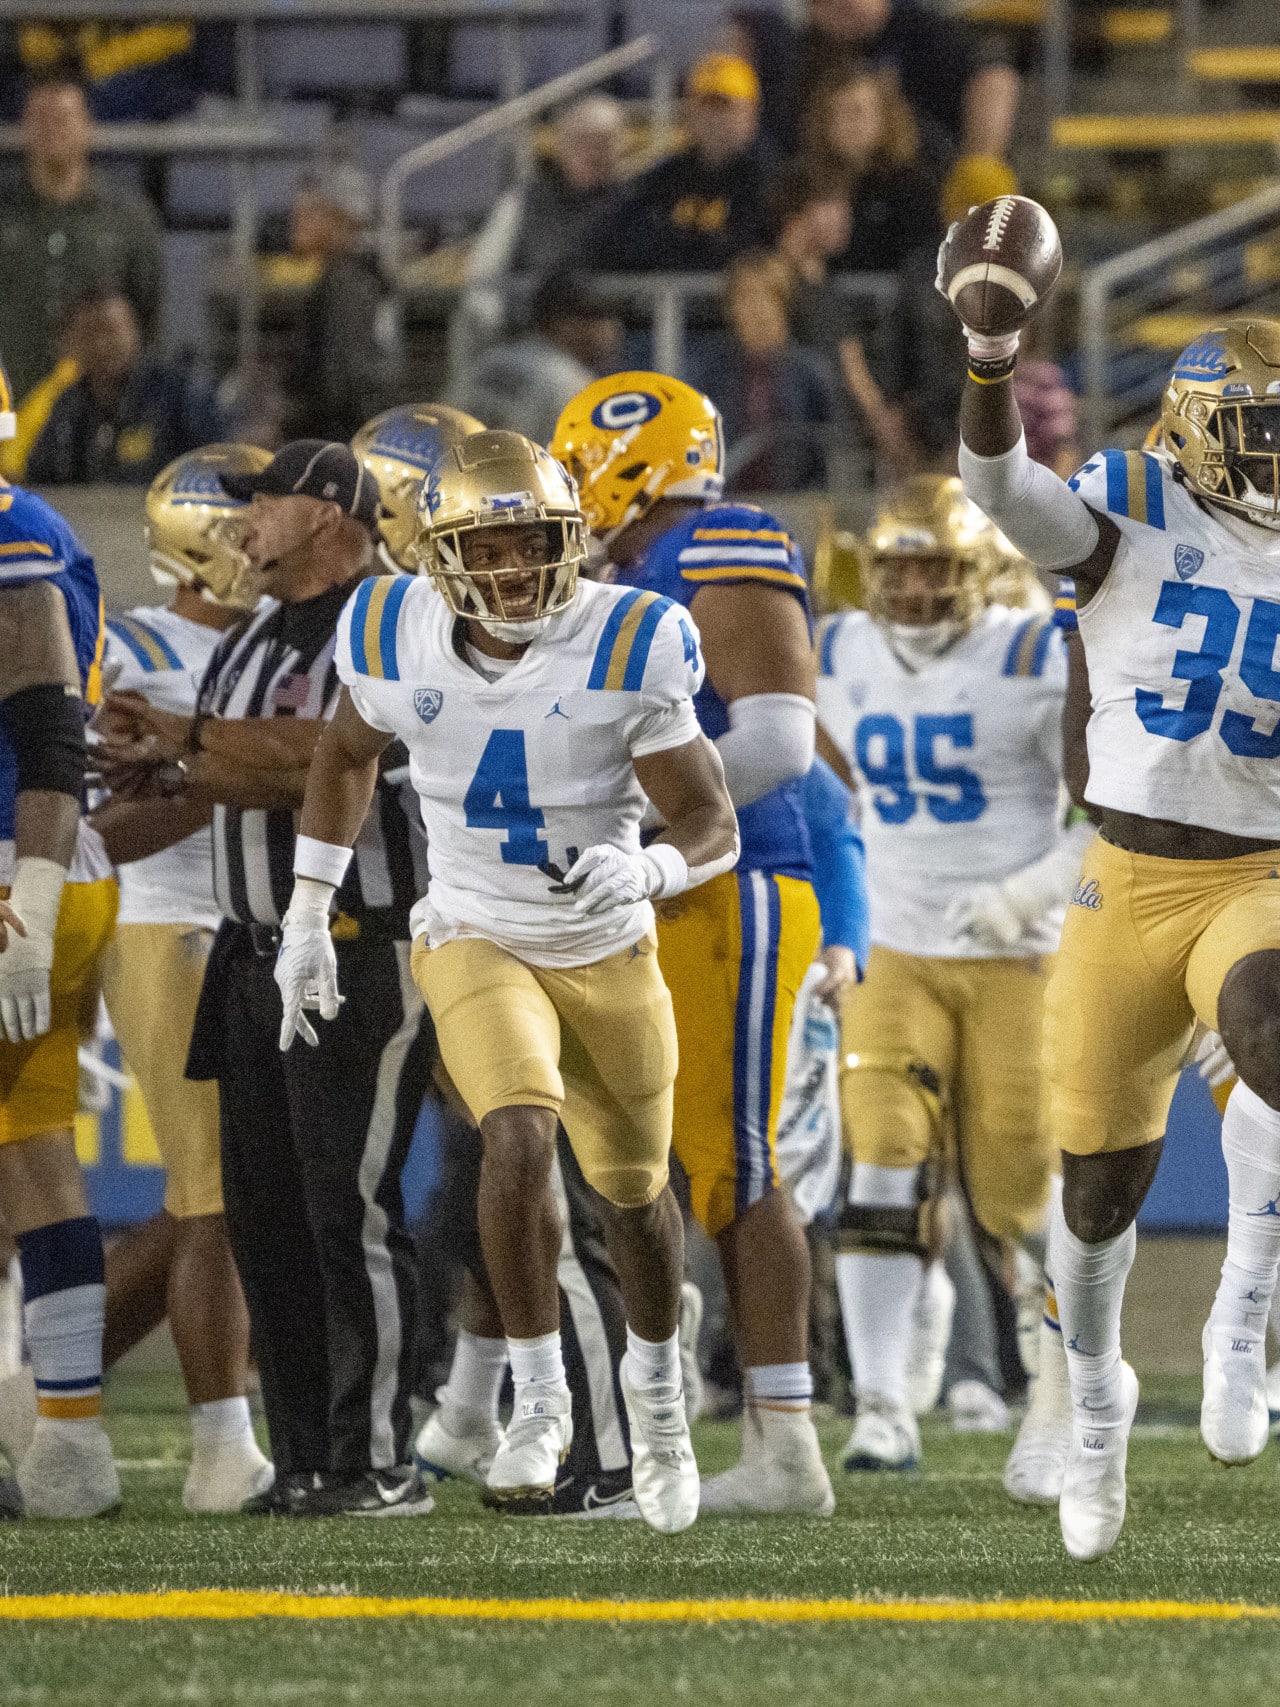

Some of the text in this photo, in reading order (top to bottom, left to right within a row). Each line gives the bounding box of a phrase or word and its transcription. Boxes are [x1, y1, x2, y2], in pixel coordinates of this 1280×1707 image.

[601, 393, 649, 428] C
[1177, 545, 1204, 570] PAC
[678, 618, 699, 674] 4
[415, 690, 441, 710] PAC
[420, 702, 435, 717] 12
[855, 713, 988, 823] 95
[463, 729, 547, 866] 4
[1083, 1438, 1105, 1451] Ucla
